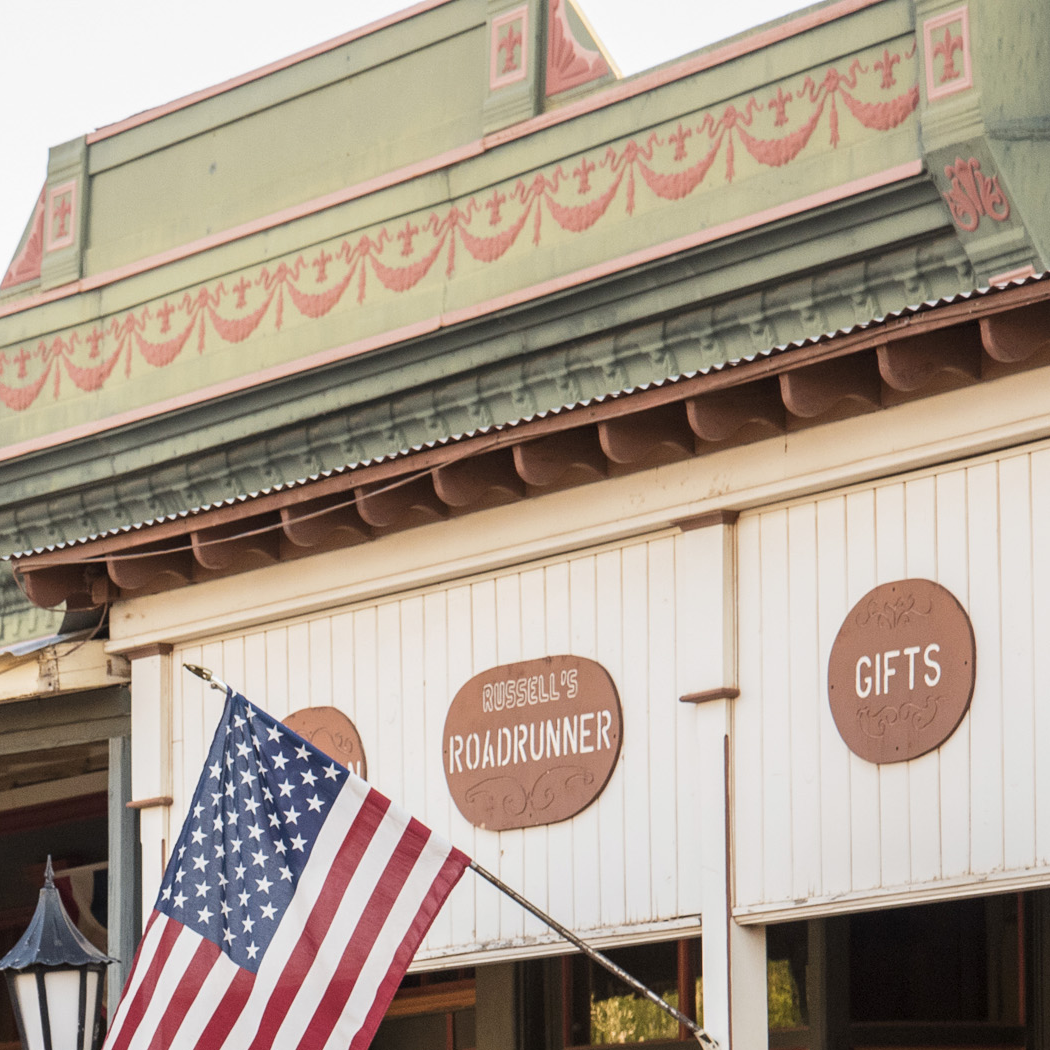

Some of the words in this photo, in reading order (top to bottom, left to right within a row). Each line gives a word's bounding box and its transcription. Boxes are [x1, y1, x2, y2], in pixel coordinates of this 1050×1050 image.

[482, 668, 578, 713] RUSSELL'S
[855, 643, 942, 699] GIFTS
[449, 709, 612, 775] ROADRUNNER
